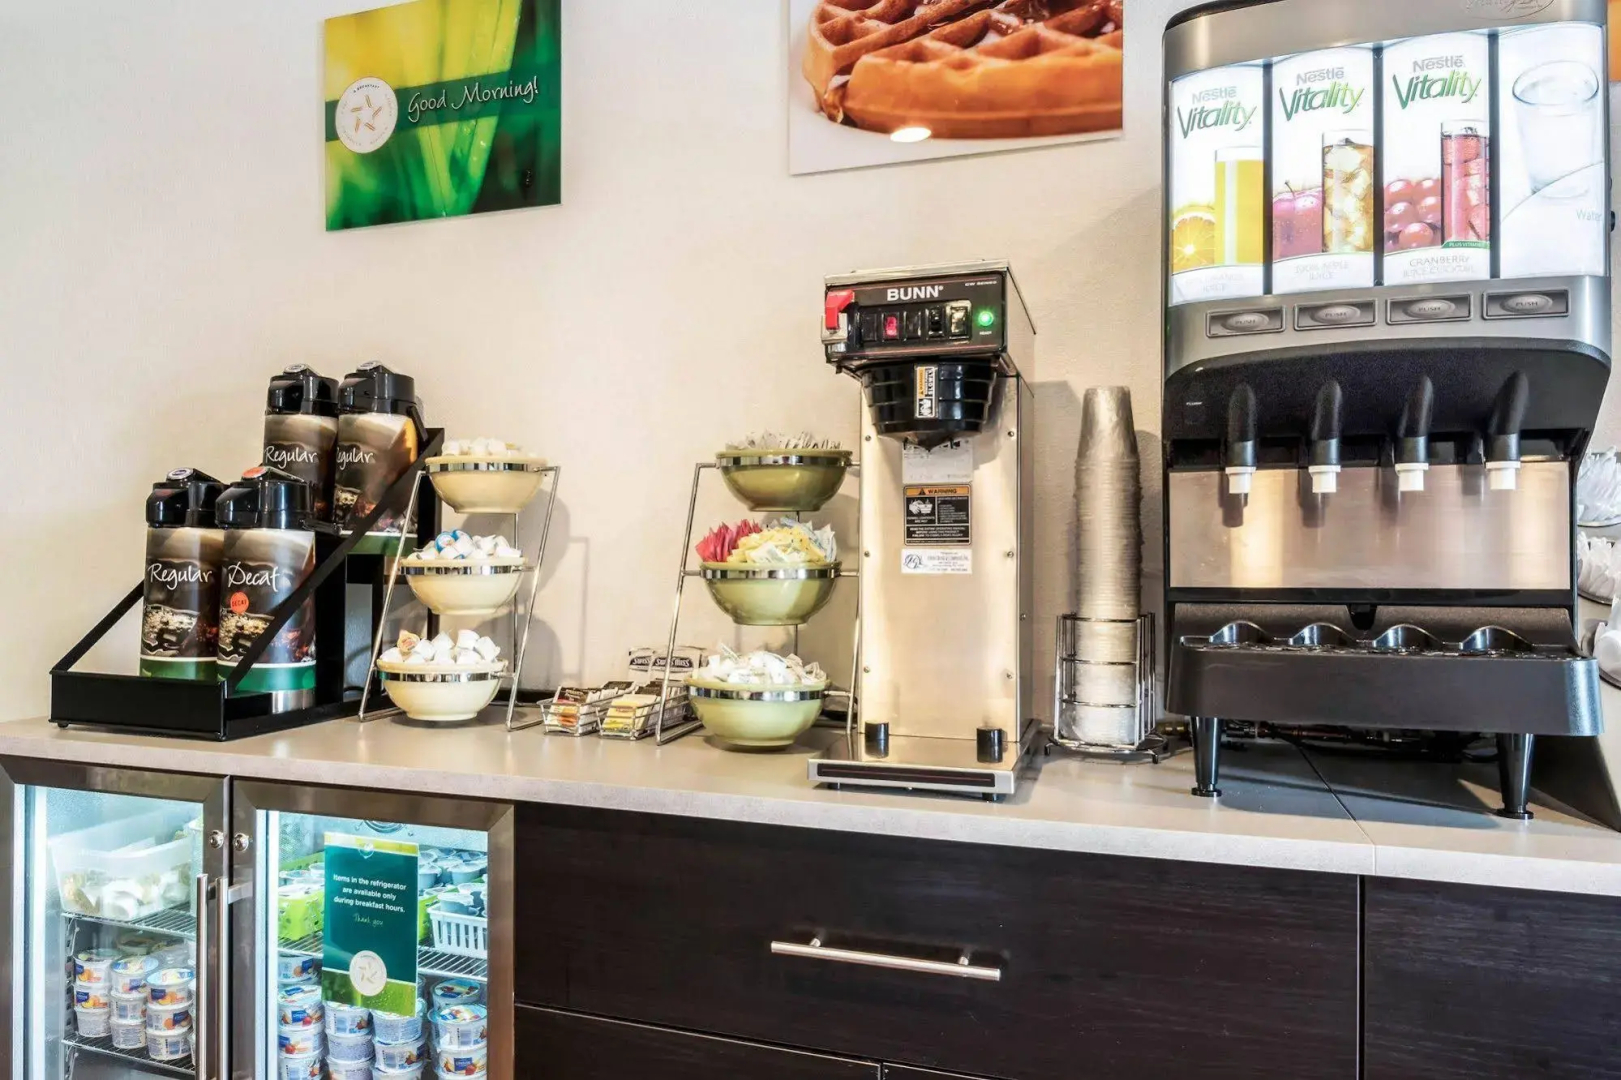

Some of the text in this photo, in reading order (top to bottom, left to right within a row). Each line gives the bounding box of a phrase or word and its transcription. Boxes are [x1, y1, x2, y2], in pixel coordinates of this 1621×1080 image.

[408, 90, 447, 123] Good
[451, 76, 539, 110] Morning!
[1278, 81, 1365, 121] Vitality
[1392, 70, 1482, 110] Vitality
[1177, 101, 1258, 139] Vitality
[887, 285, 937, 302] BUNN
[264, 446, 317, 469] Regular
[336, 447, 374, 470] egular
[927, 488, 958, 496] WARNING
[147, 563, 212, 590] Regular
[228, 561, 280, 593] Decaf
[333, 874, 350, 882] Items
[358, 878, 369, 886] the
[370, 880, 407, 890] refrigerator
[342, 886, 397, 901] are available only
[333, 896, 406, 912] during breakfast hours.
